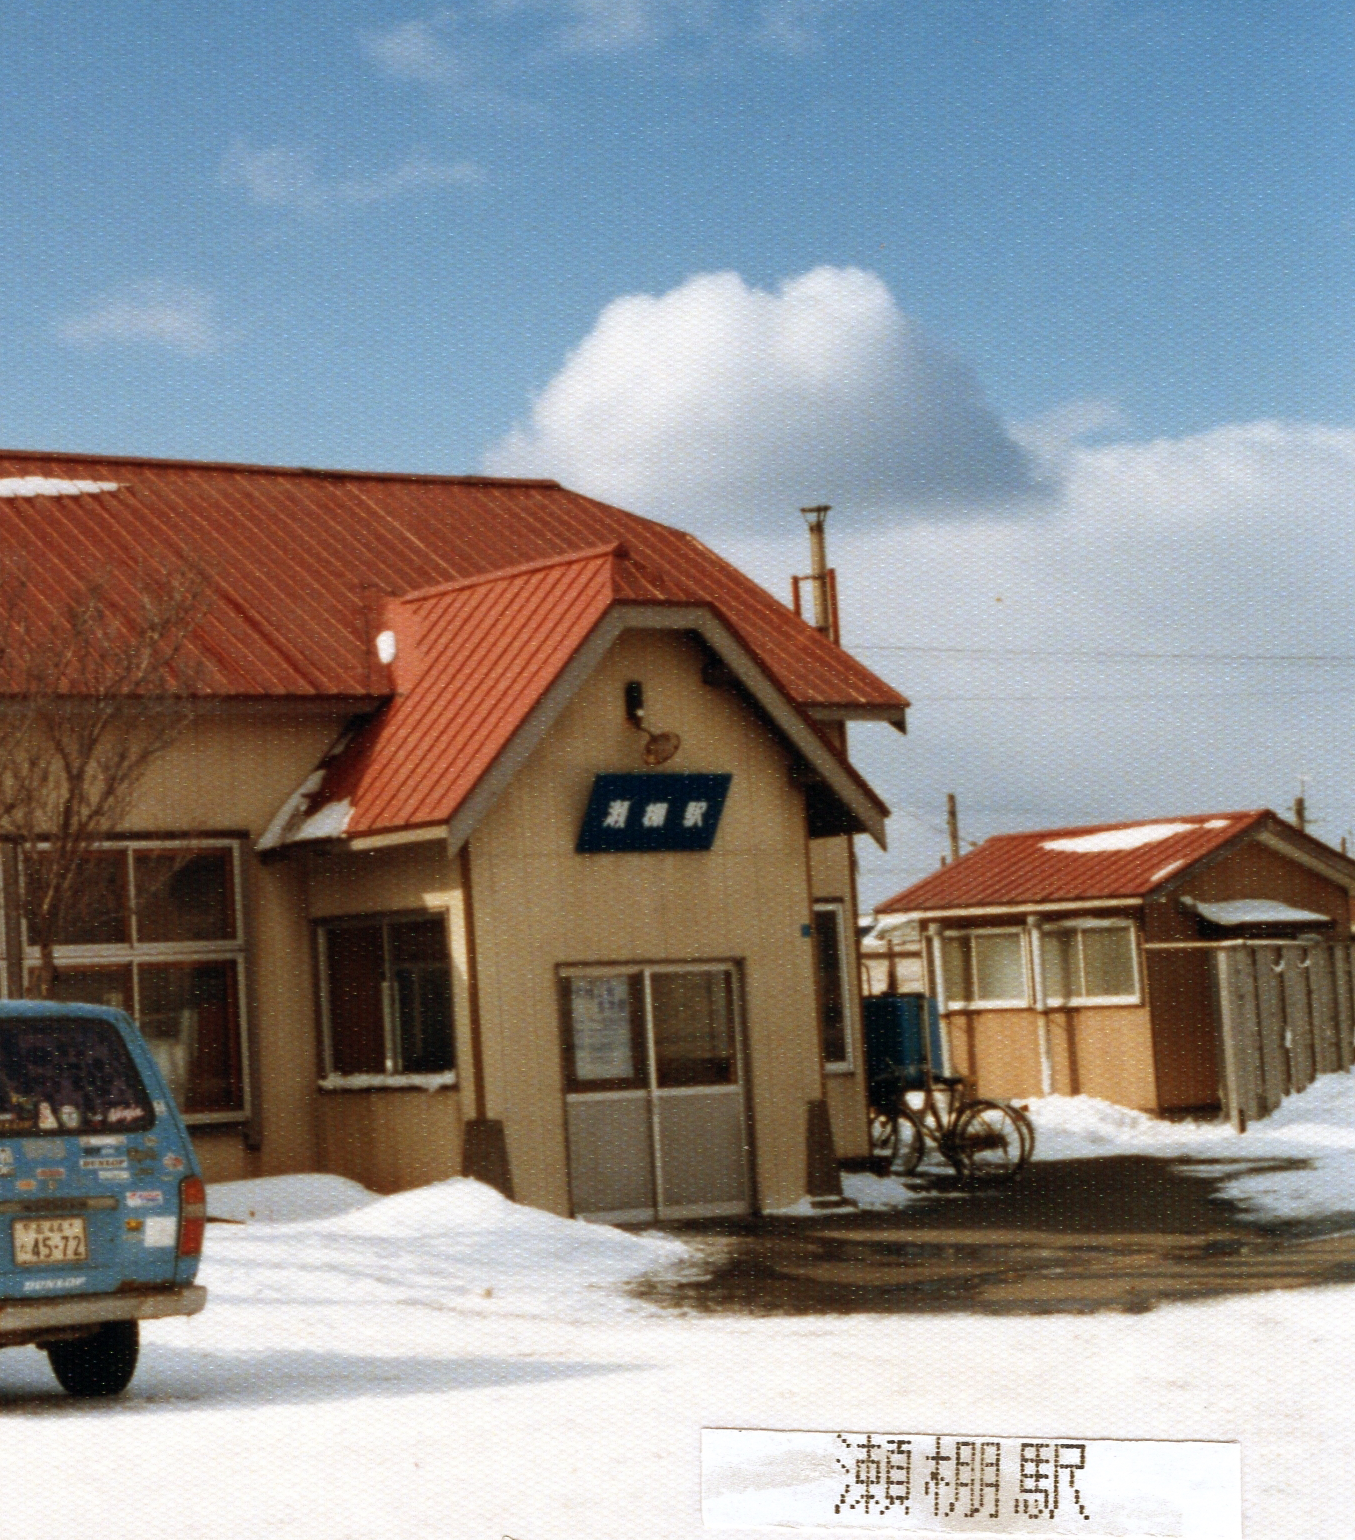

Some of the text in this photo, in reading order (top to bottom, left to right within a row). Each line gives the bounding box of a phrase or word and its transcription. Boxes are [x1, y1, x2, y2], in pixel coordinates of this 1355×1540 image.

[83, 1159, 125, 1168] DUNLOP
[31, 1236, 83, 1258] 45-72
[23, 1277, 87, 1291] DUNLOP
